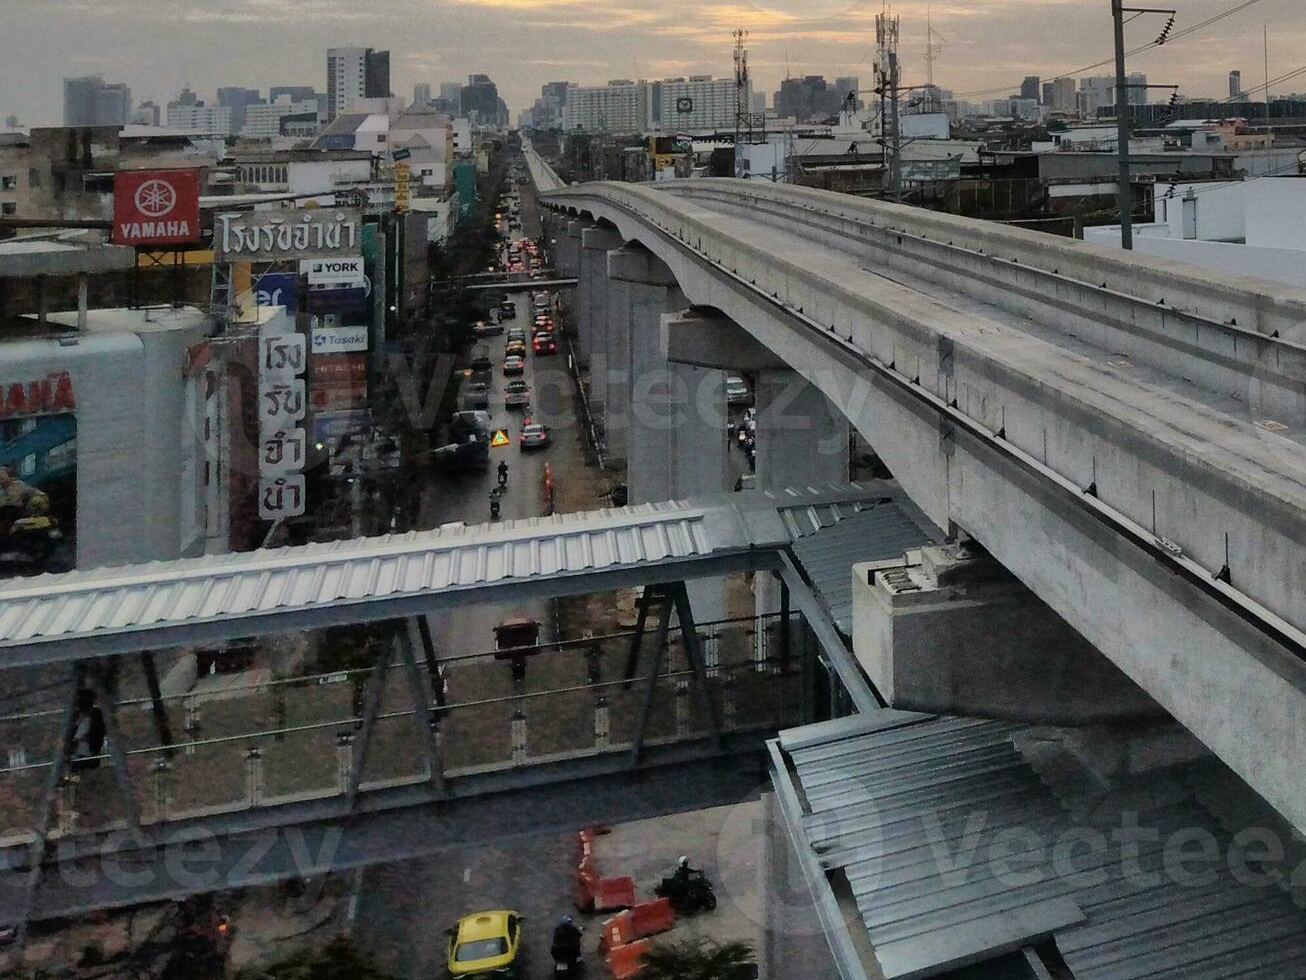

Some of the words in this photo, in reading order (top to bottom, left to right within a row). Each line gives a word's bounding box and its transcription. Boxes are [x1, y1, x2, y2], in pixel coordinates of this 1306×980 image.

[120, 220, 190, 239] YAMAHA
[325, 262, 359, 273] YORK
[329, 335, 365, 345] Tasaki
[314, 363, 366, 373] HITACHI
